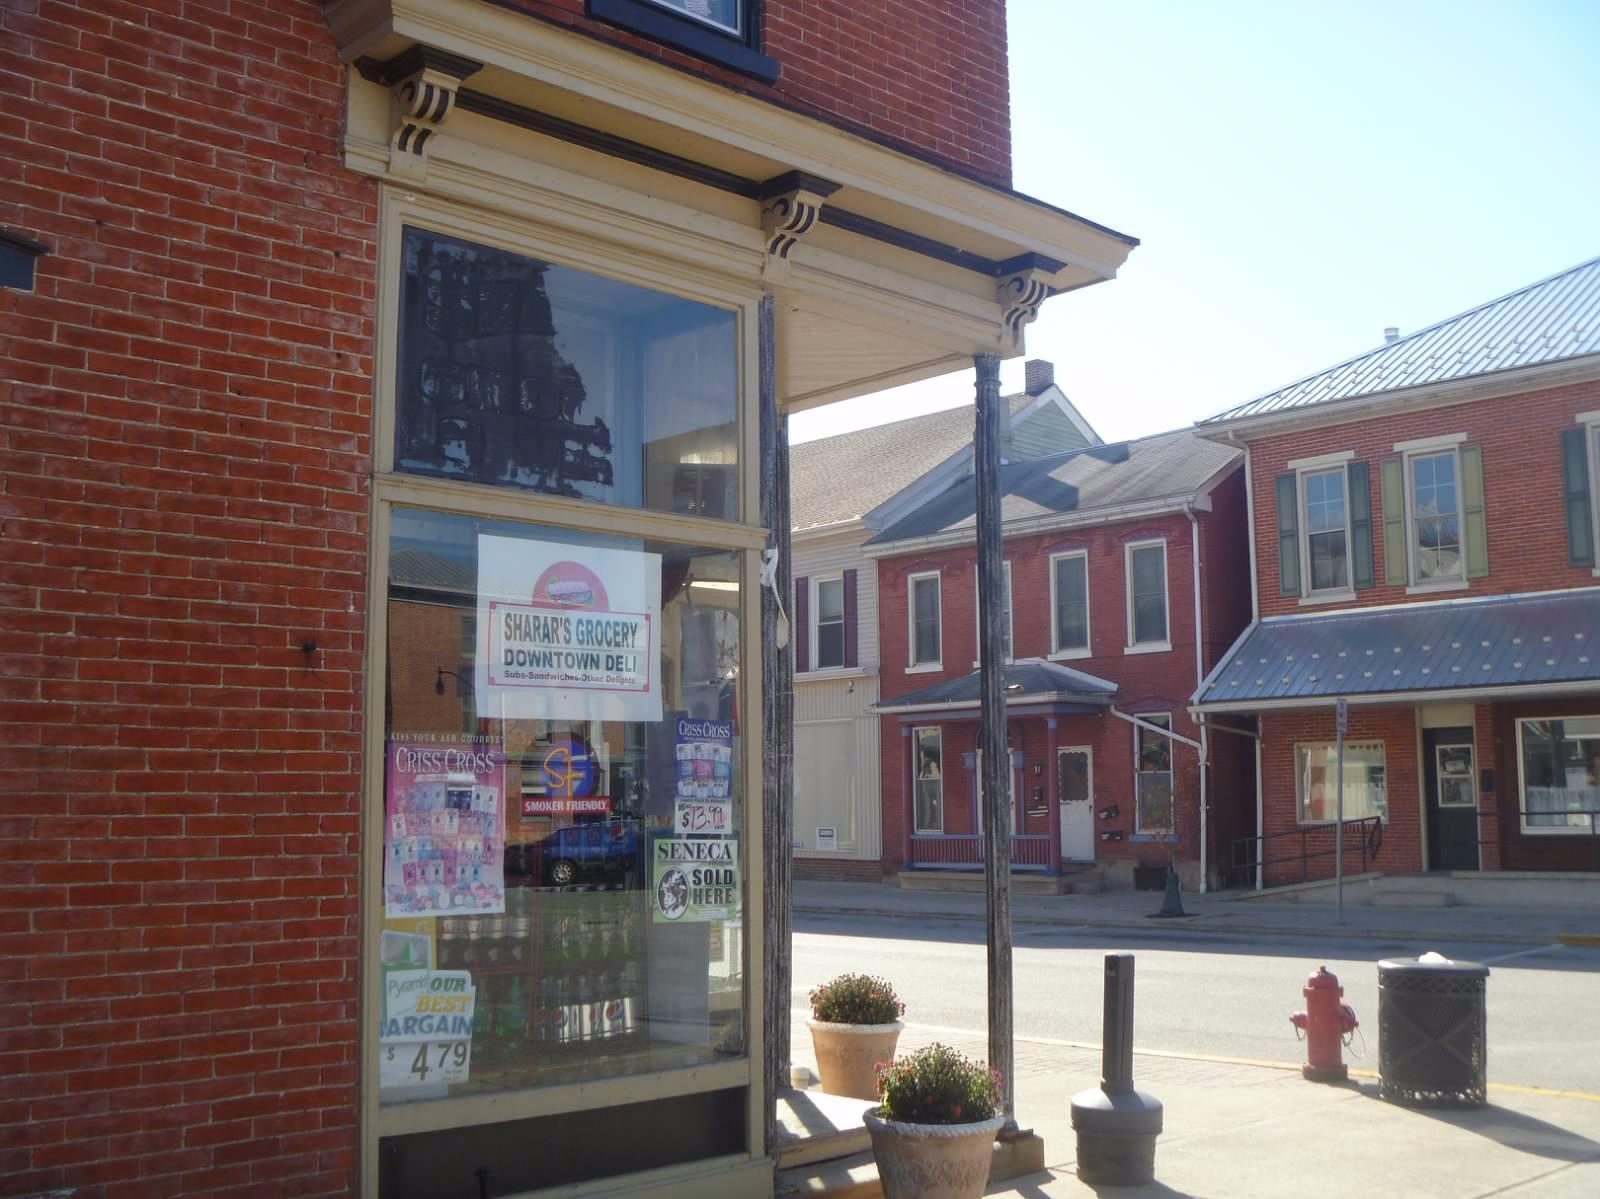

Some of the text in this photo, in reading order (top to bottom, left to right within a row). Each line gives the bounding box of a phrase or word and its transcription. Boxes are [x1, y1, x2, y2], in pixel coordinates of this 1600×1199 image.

[504, 612, 638, 648] SHARAR'S GROCERY
[504, 648, 637, 672] DOWNTOWN DELI
[606, 675, 636, 686] Delights
[524, 799, 608, 812] SMOKER FRIENDLY
[657, 842, 732, 860] SENECA
[692, 868, 733, 886] SOLD
[693, 887, 733, 905] HERE
[430, 977, 466, 992] OUR
[416, 994, 472, 1013] BEST
